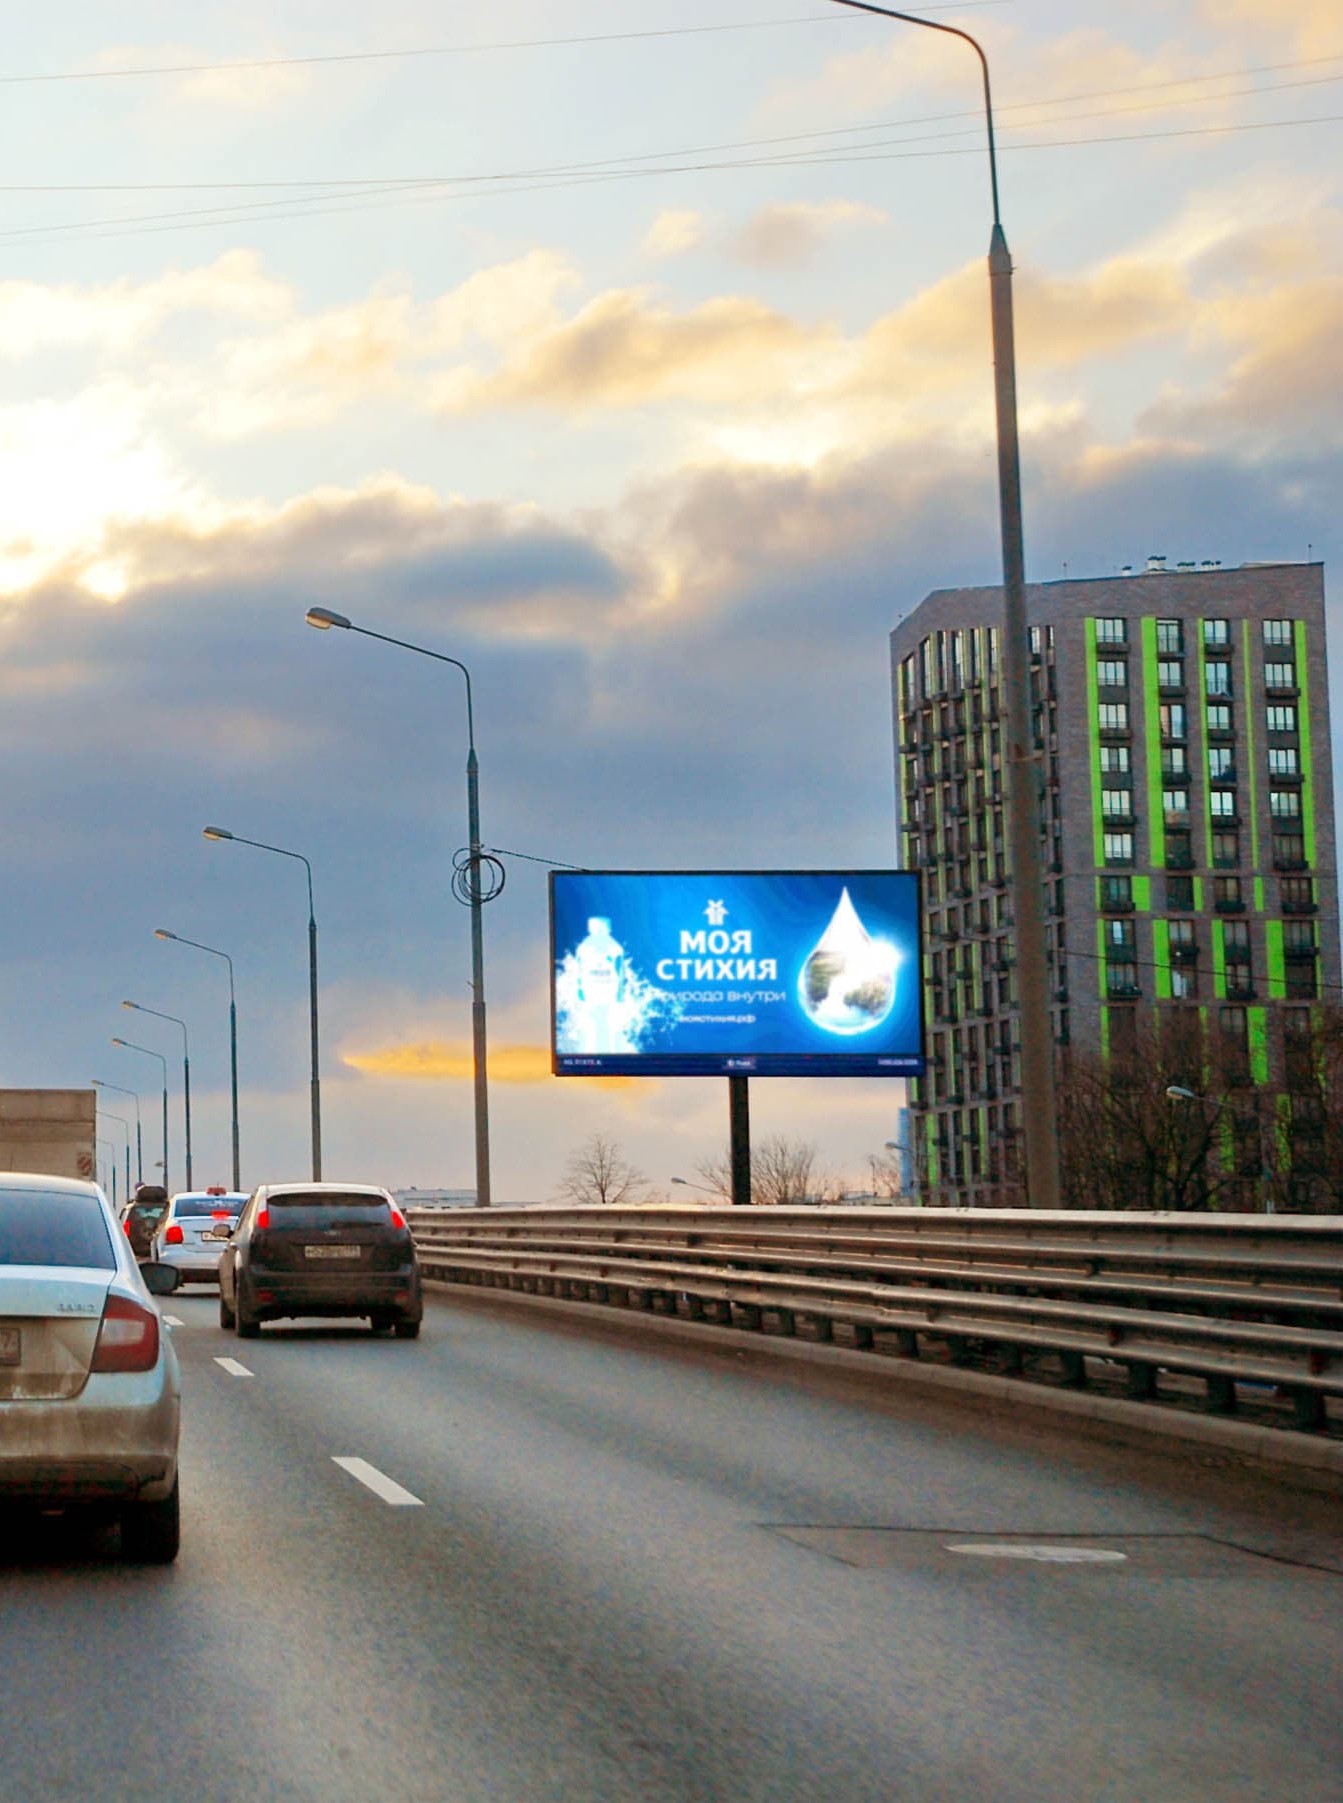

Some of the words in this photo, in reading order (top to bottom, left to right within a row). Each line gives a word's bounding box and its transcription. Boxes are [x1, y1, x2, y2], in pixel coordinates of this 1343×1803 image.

[680, 930, 752, 954] МОЯ
[656, 959, 777, 980] СТИХИЯ
[652, 991, 724, 1003] рирода
